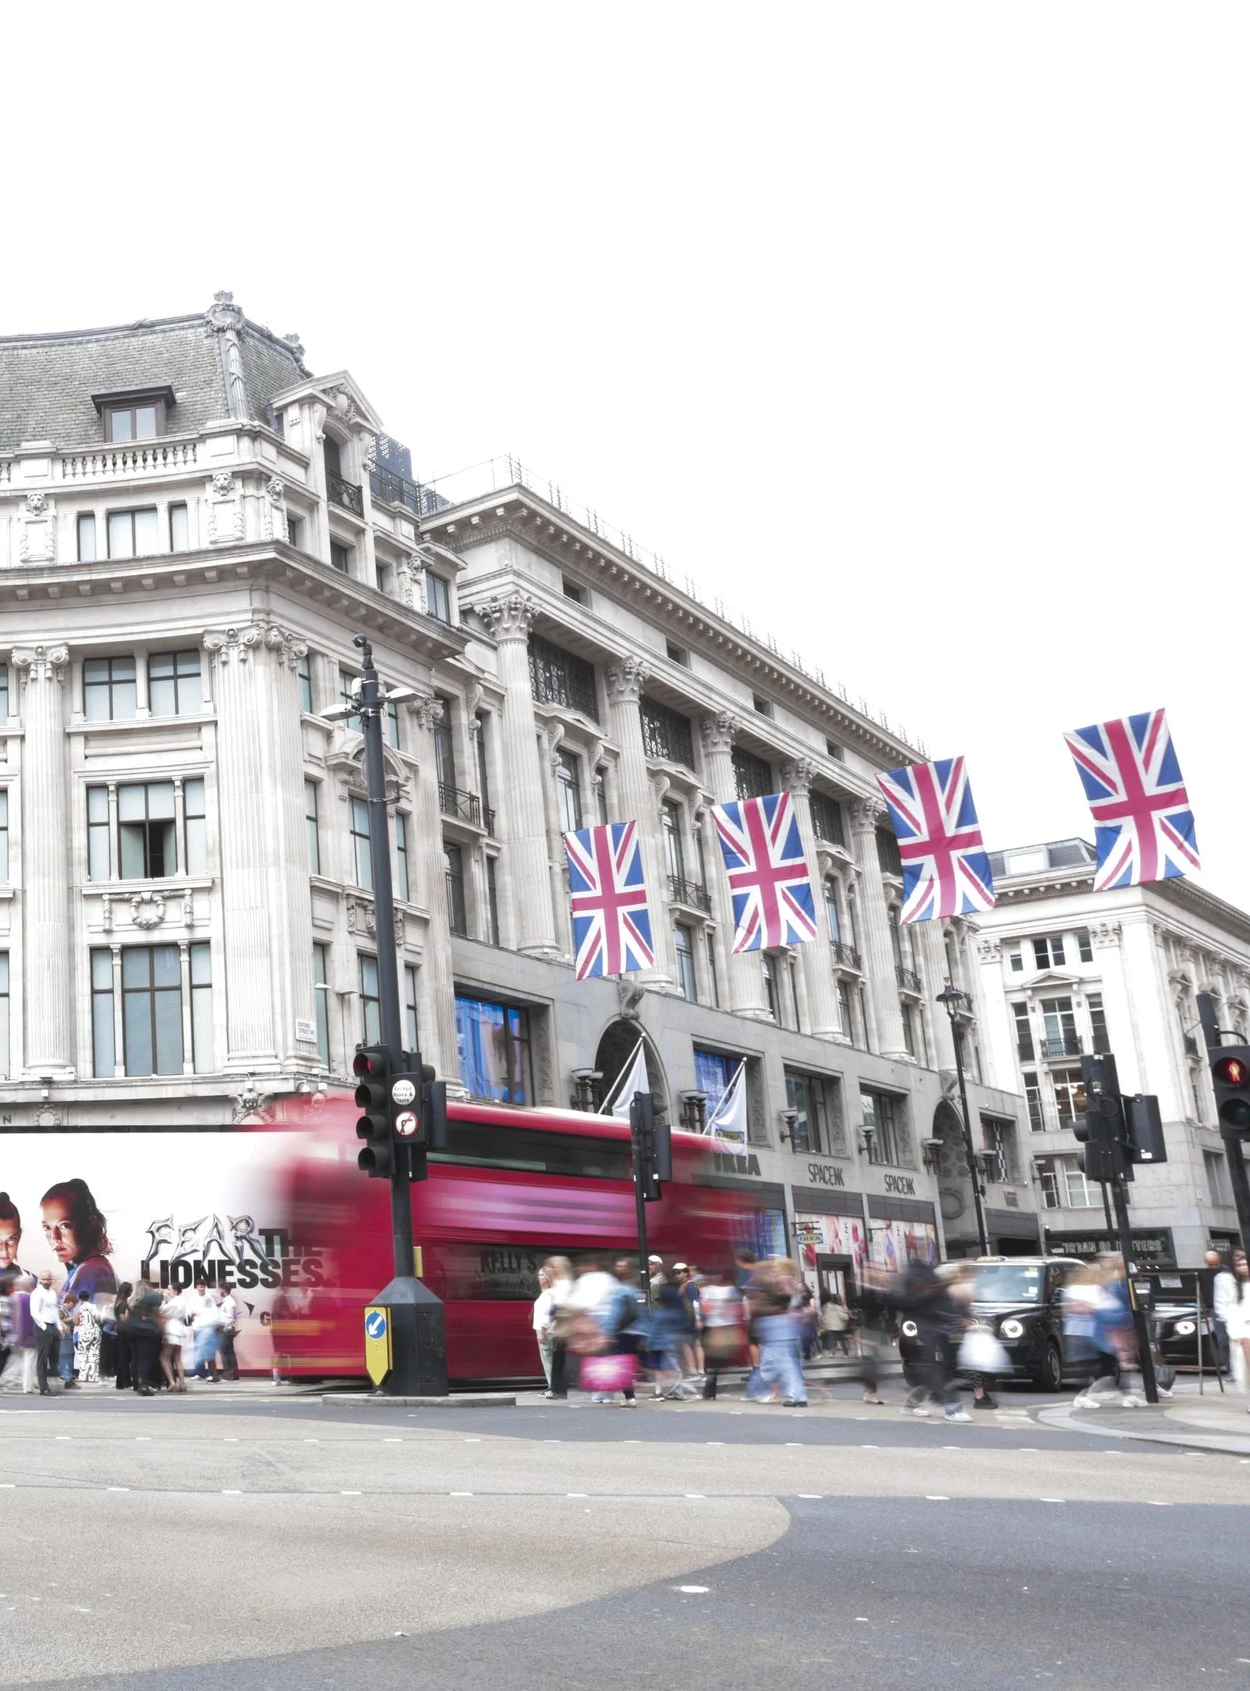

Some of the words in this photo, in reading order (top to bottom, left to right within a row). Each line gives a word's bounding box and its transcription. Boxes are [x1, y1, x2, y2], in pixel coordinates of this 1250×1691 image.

[714, 1153, 761, 1176] IKEA
[146, 1213, 275, 1266] FEAR
[259, 1228, 322, 1258] THE
